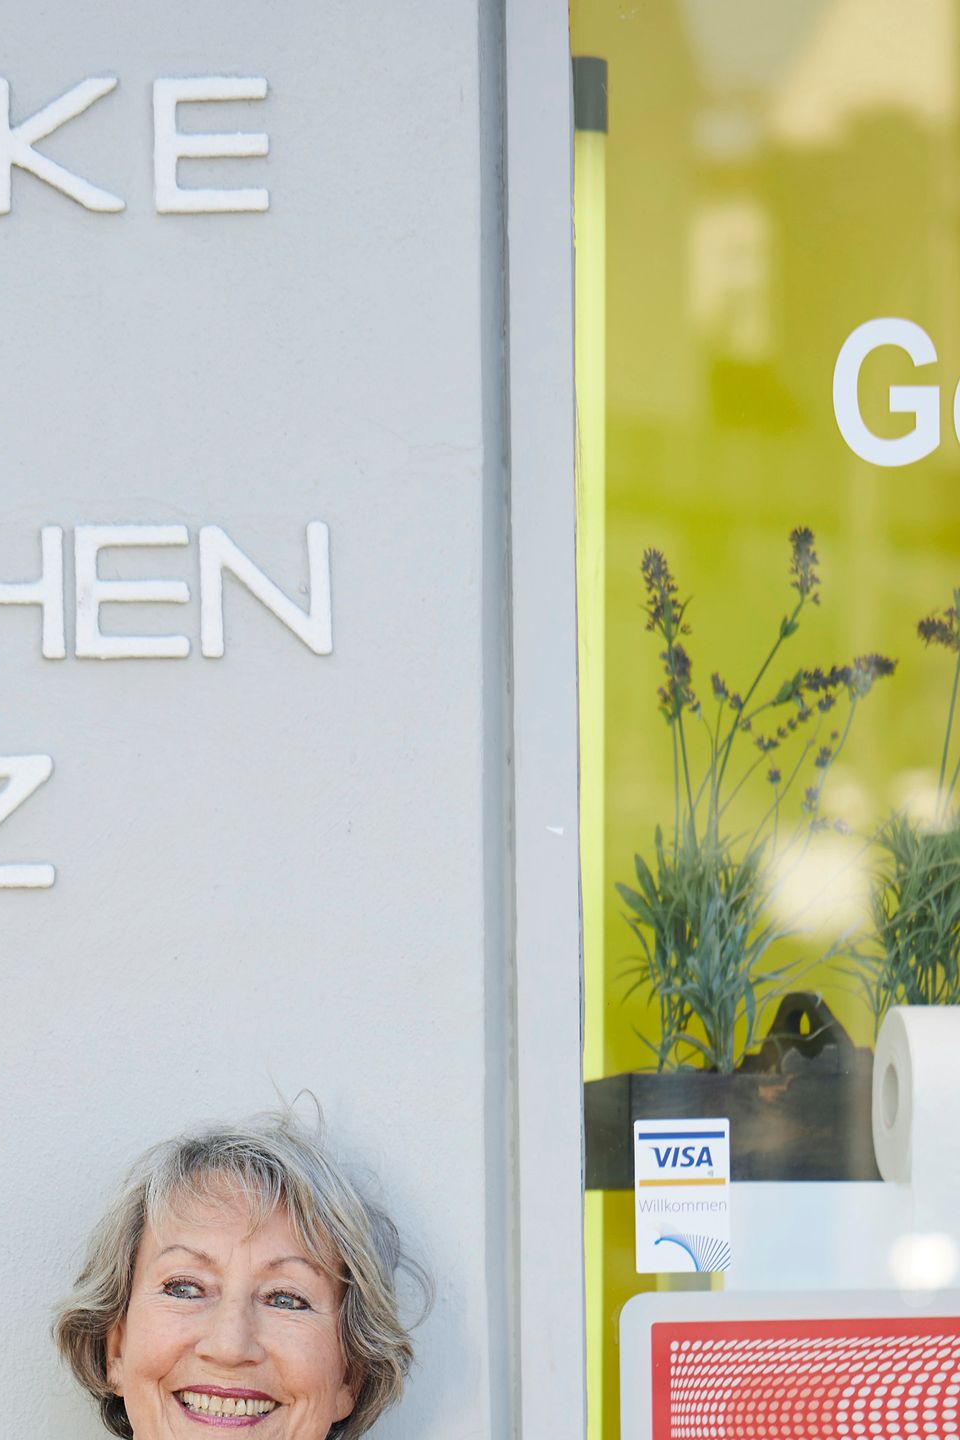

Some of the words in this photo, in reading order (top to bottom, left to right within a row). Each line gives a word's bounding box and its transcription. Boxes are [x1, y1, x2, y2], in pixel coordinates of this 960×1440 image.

[832, 317, 960, 467] G
[651, 1146, 713, 1168] VISA
[639, 1198, 728, 1213] Willkommen
